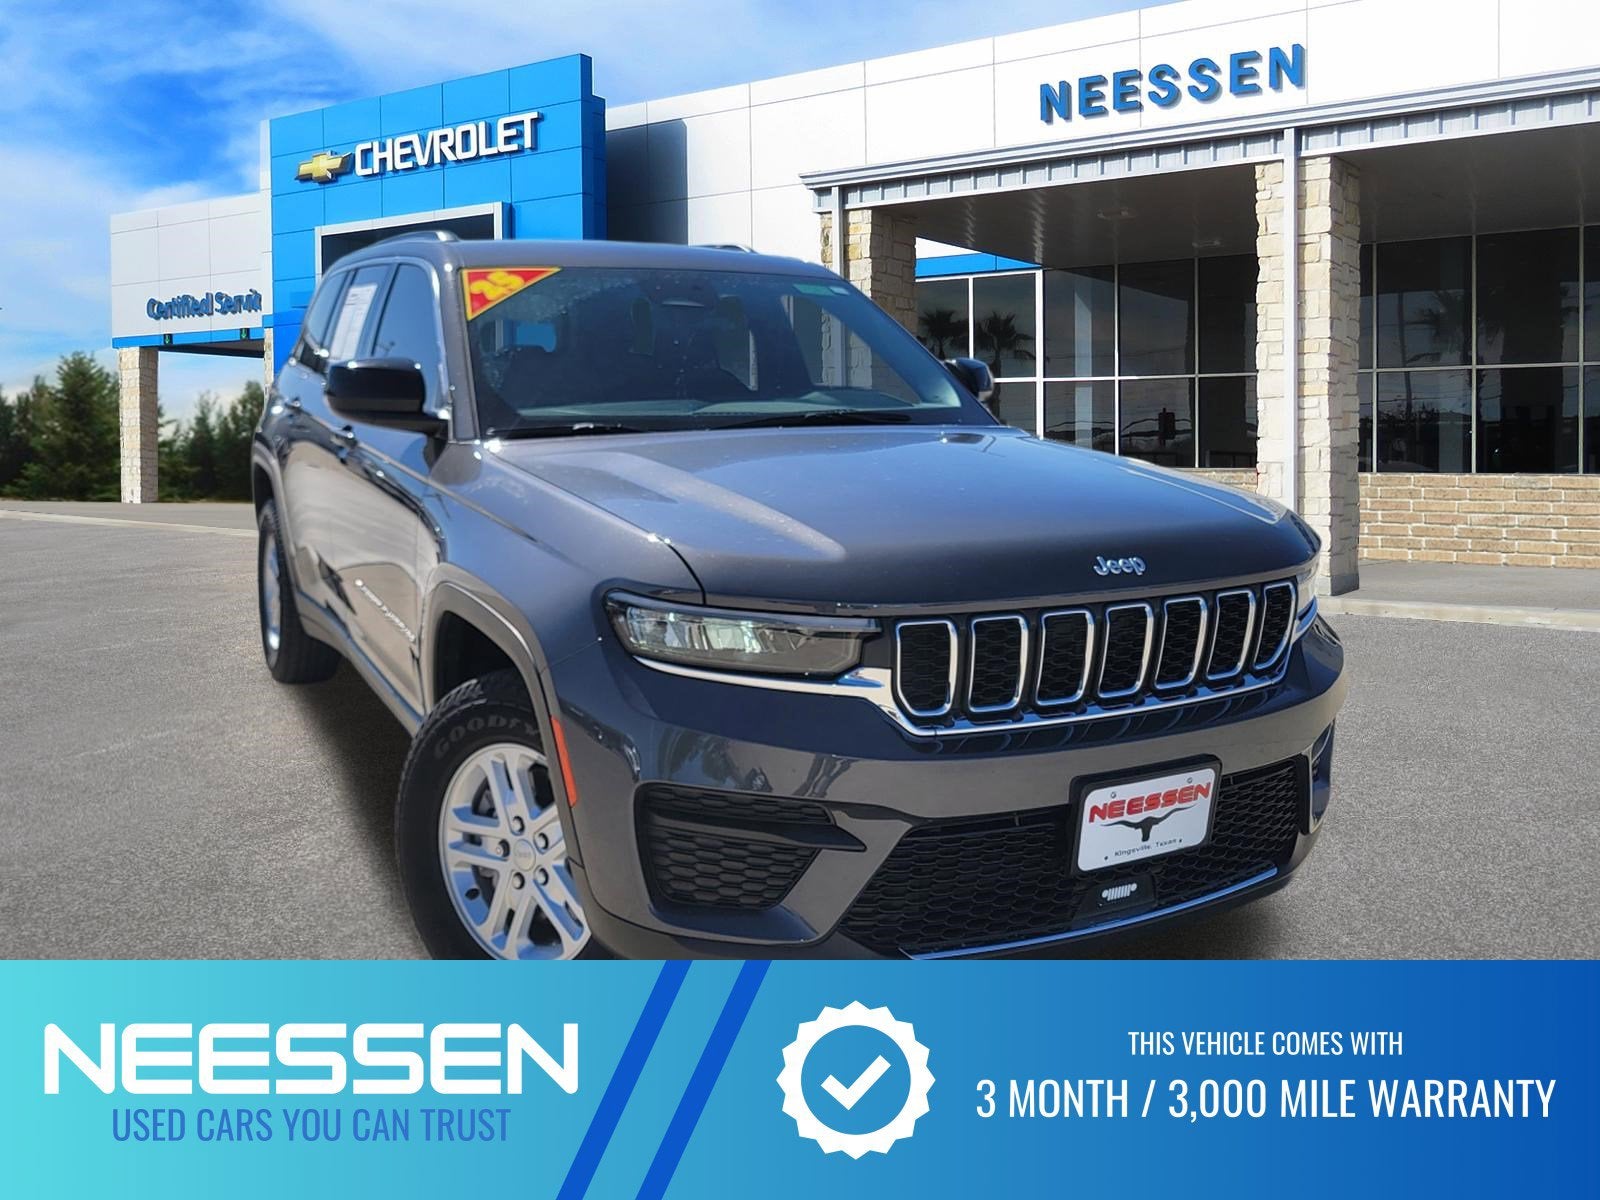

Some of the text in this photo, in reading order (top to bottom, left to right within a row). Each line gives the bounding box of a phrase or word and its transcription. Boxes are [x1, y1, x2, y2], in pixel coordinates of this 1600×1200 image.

[1040, 43, 1306, 125] NEESSEN
[355, 111, 543, 177] CHEVROLET
[146, 292, 214, 321] Certified
[1093, 555, 1147, 576] Jeep
[1088, 782, 1212, 823] NEESSEN
